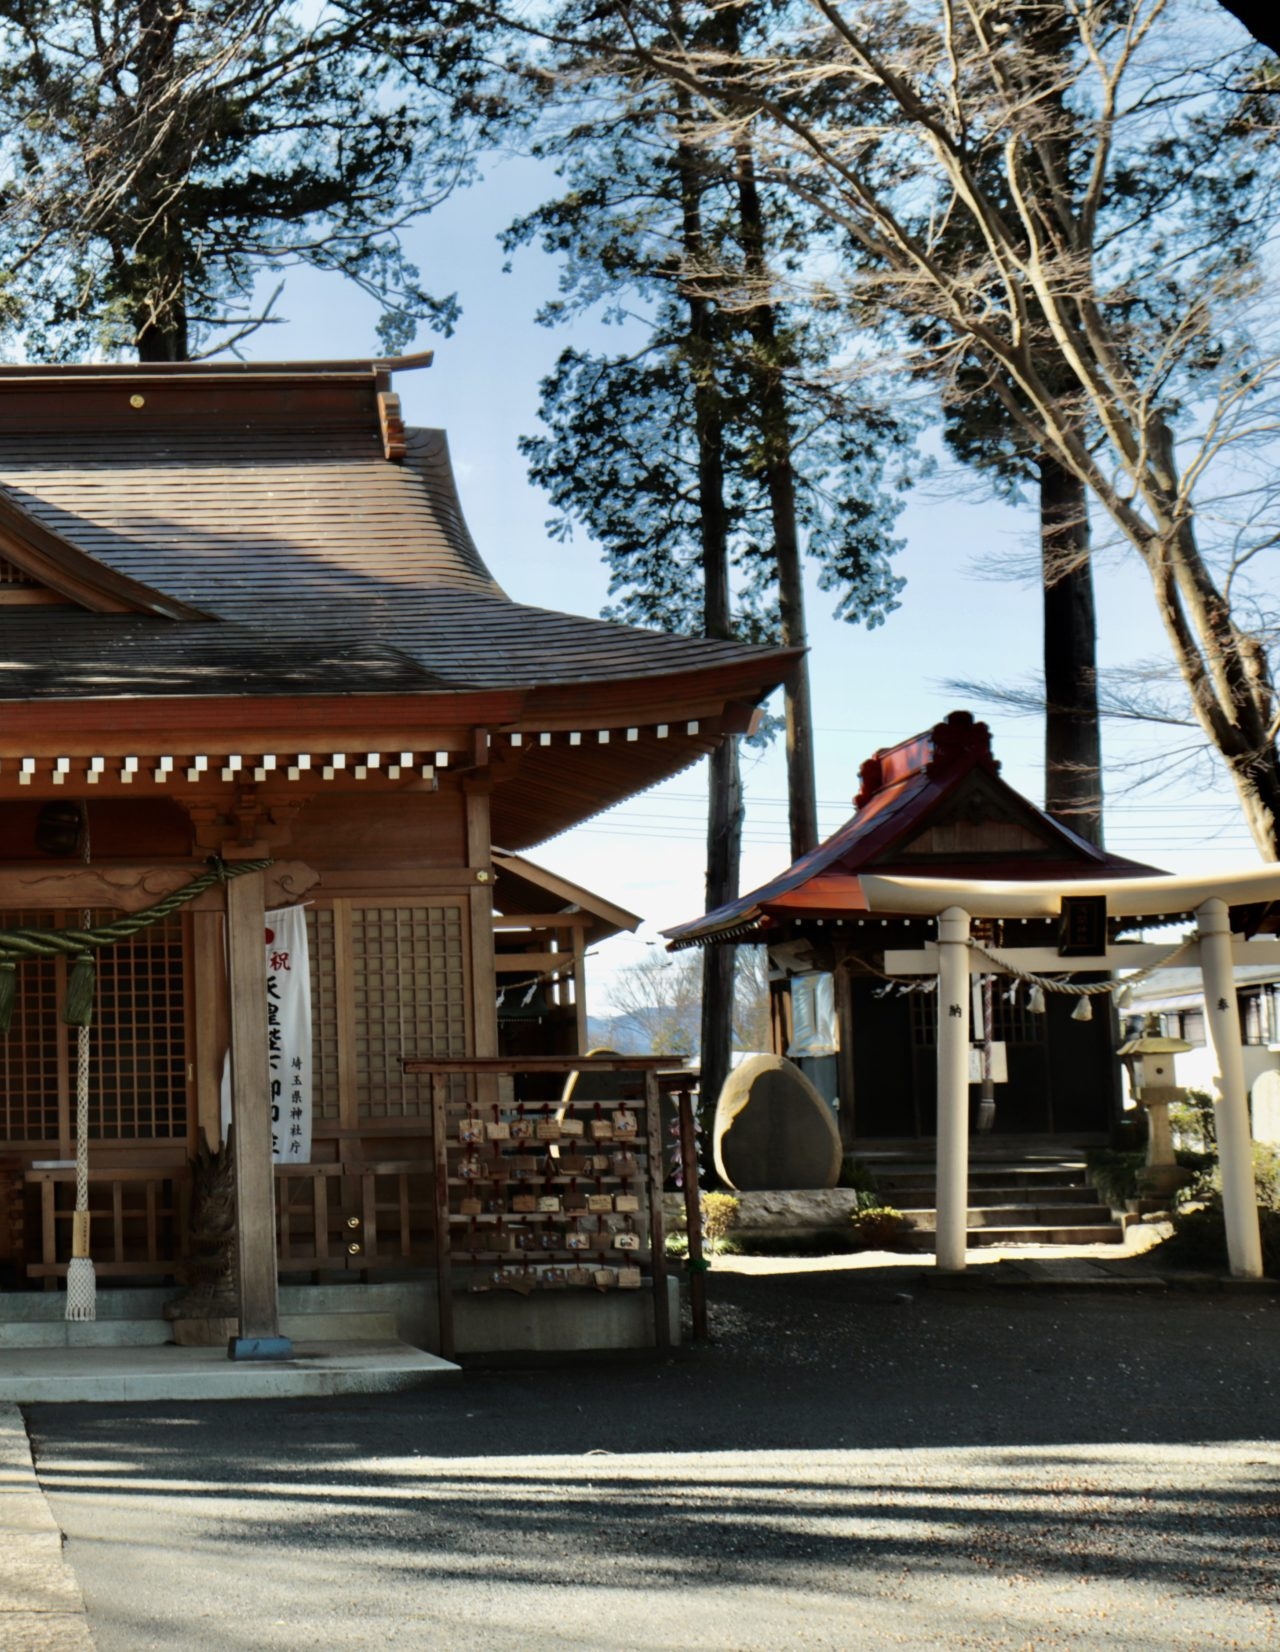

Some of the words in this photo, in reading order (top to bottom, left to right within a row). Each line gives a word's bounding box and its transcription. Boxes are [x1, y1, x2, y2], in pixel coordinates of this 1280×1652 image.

[270, 952, 291, 971] 祝
[289, 1056, 303, 1154] 埼玉県神社庁
